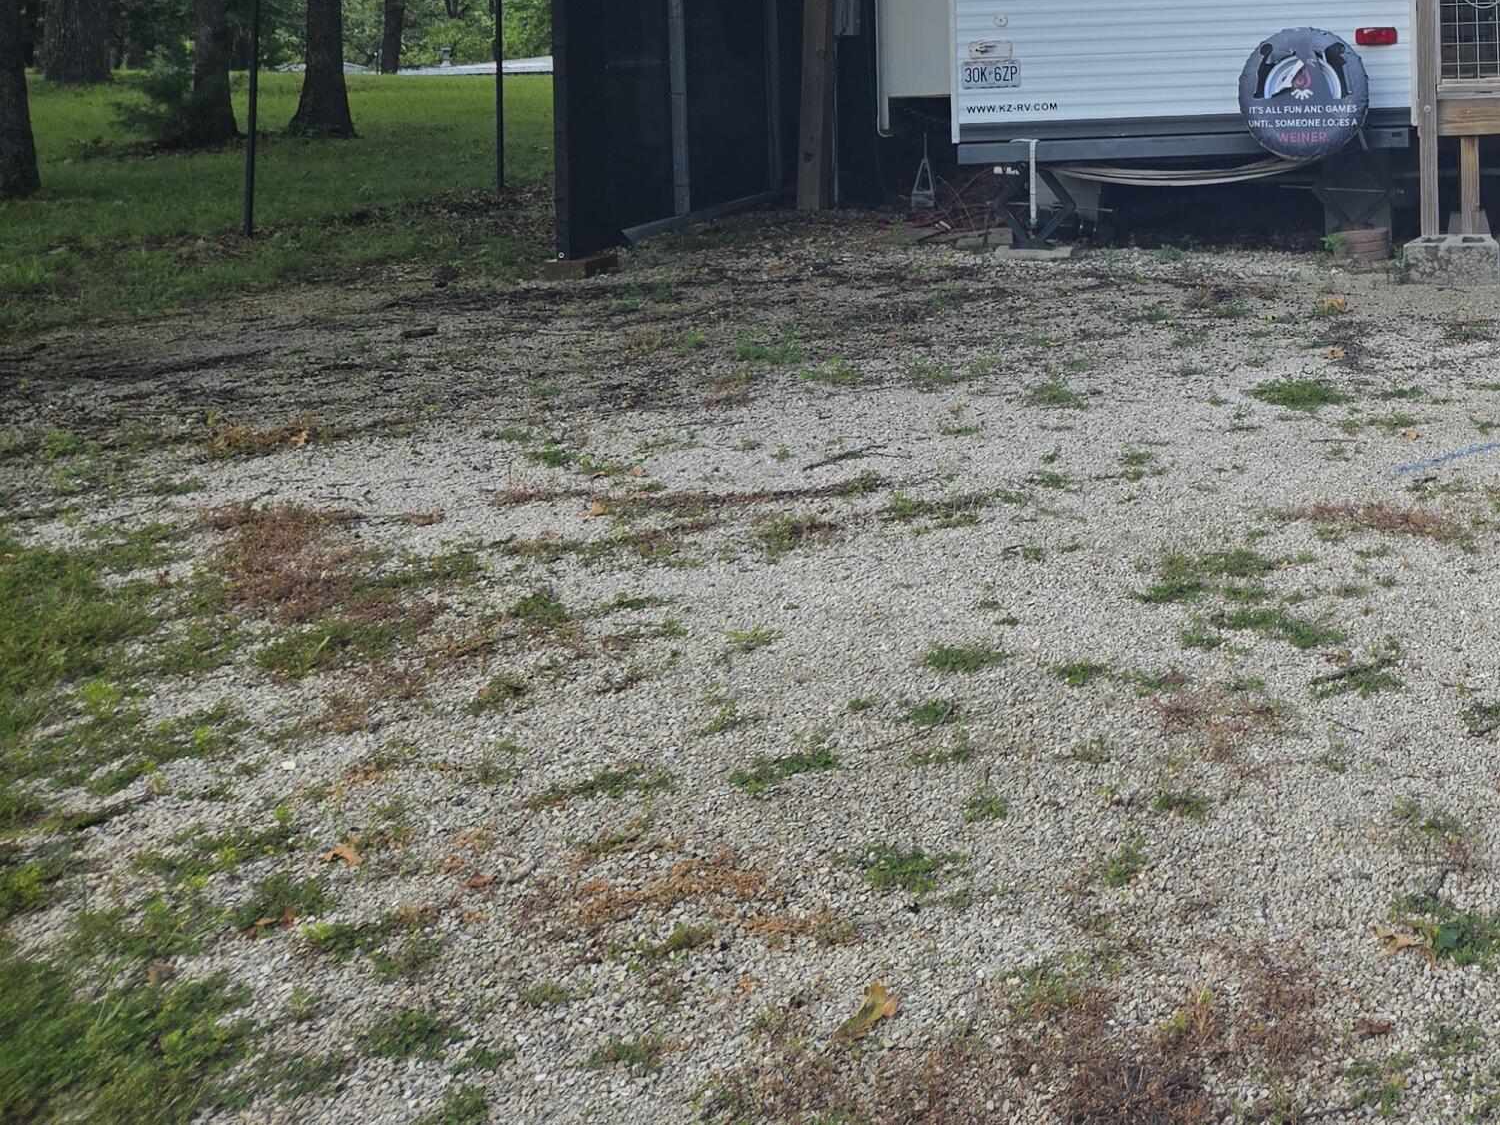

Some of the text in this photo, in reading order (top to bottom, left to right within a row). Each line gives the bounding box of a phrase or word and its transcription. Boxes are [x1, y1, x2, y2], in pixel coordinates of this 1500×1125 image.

[964, 65, 1018, 83] 30K 6ZP
[966, 102, 1058, 114] WWW.KZ-RV.COM
[1248, 104, 1358, 114] IT'S ALL FUN AND GAMES
[1275, 118, 1321, 128] SOMEONE
[1351, 118, 1358, 126] A
